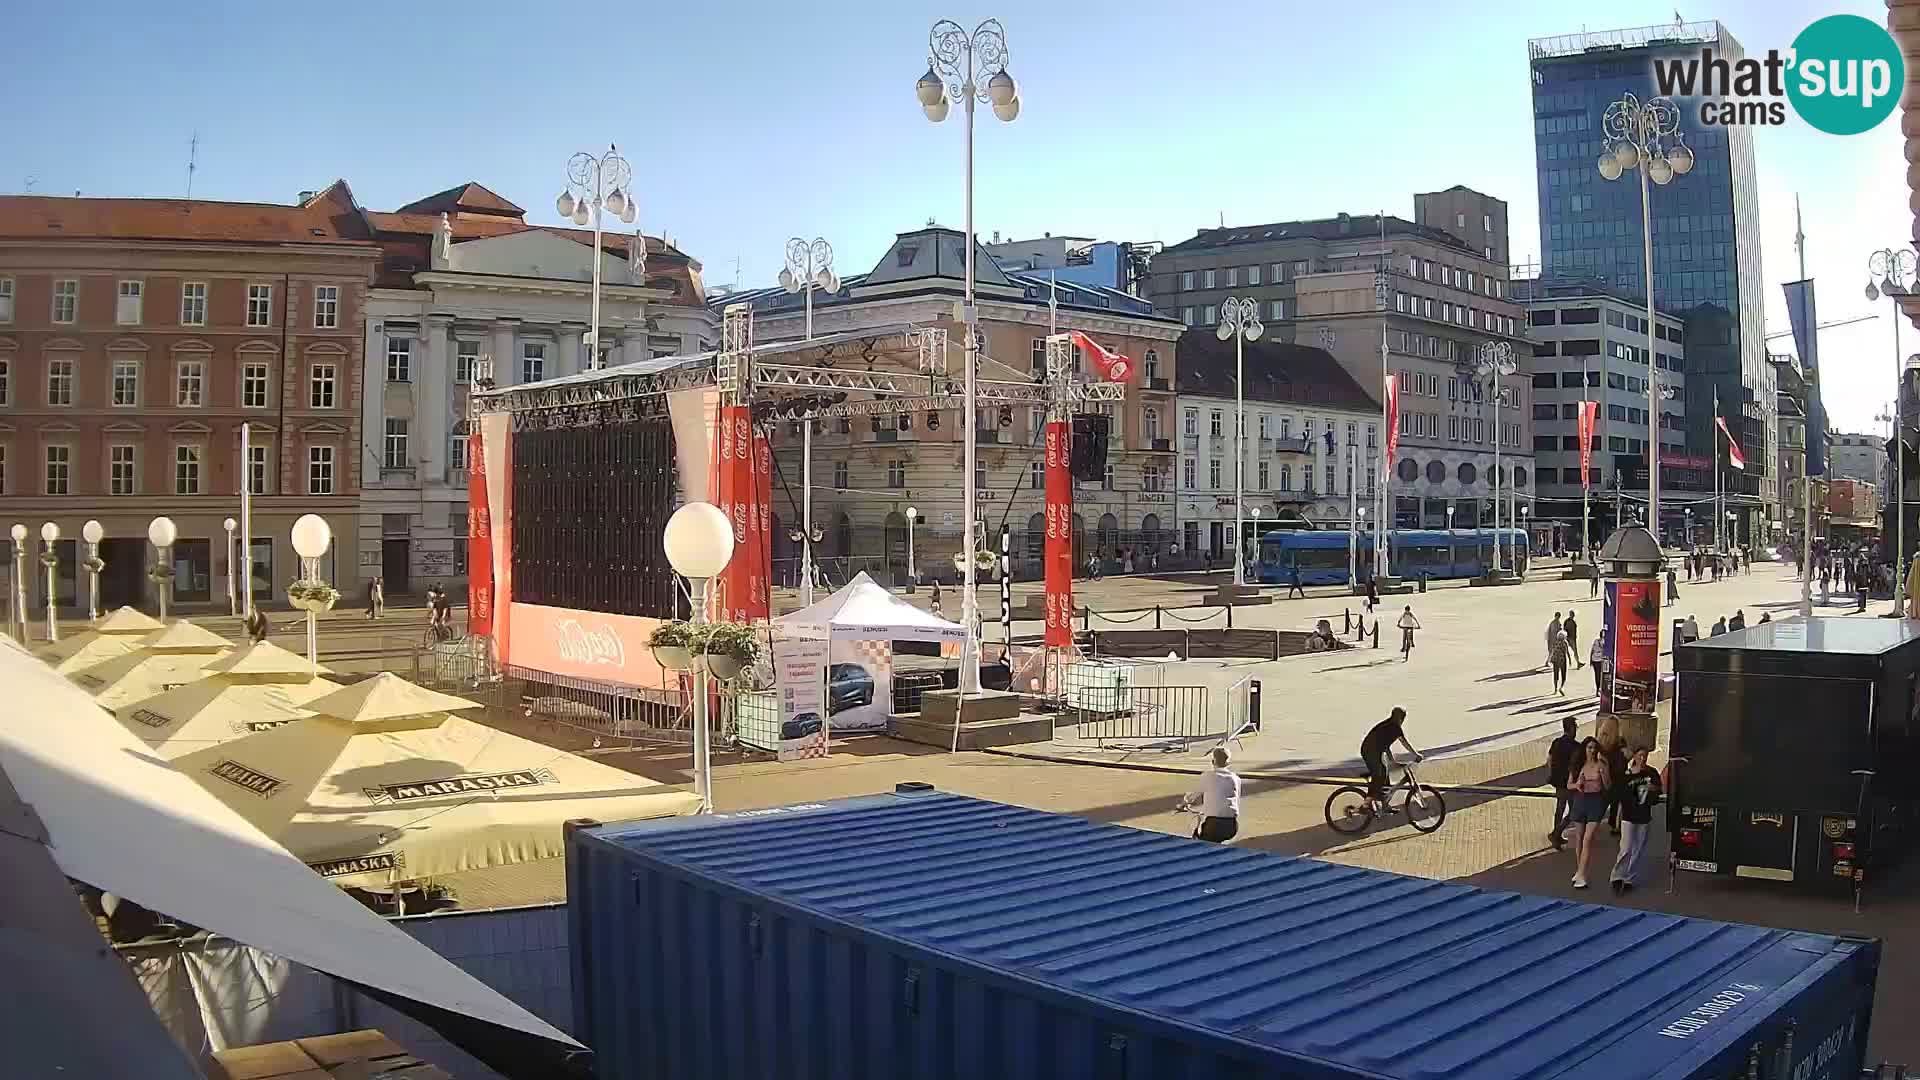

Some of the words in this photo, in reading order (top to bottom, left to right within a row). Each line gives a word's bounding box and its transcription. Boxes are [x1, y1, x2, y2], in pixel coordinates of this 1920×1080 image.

[1626, 624, 1647, 632] VIDEO
[397, 773, 532, 800] MARASKA
[1691, 990, 1746, 1018] 300629
